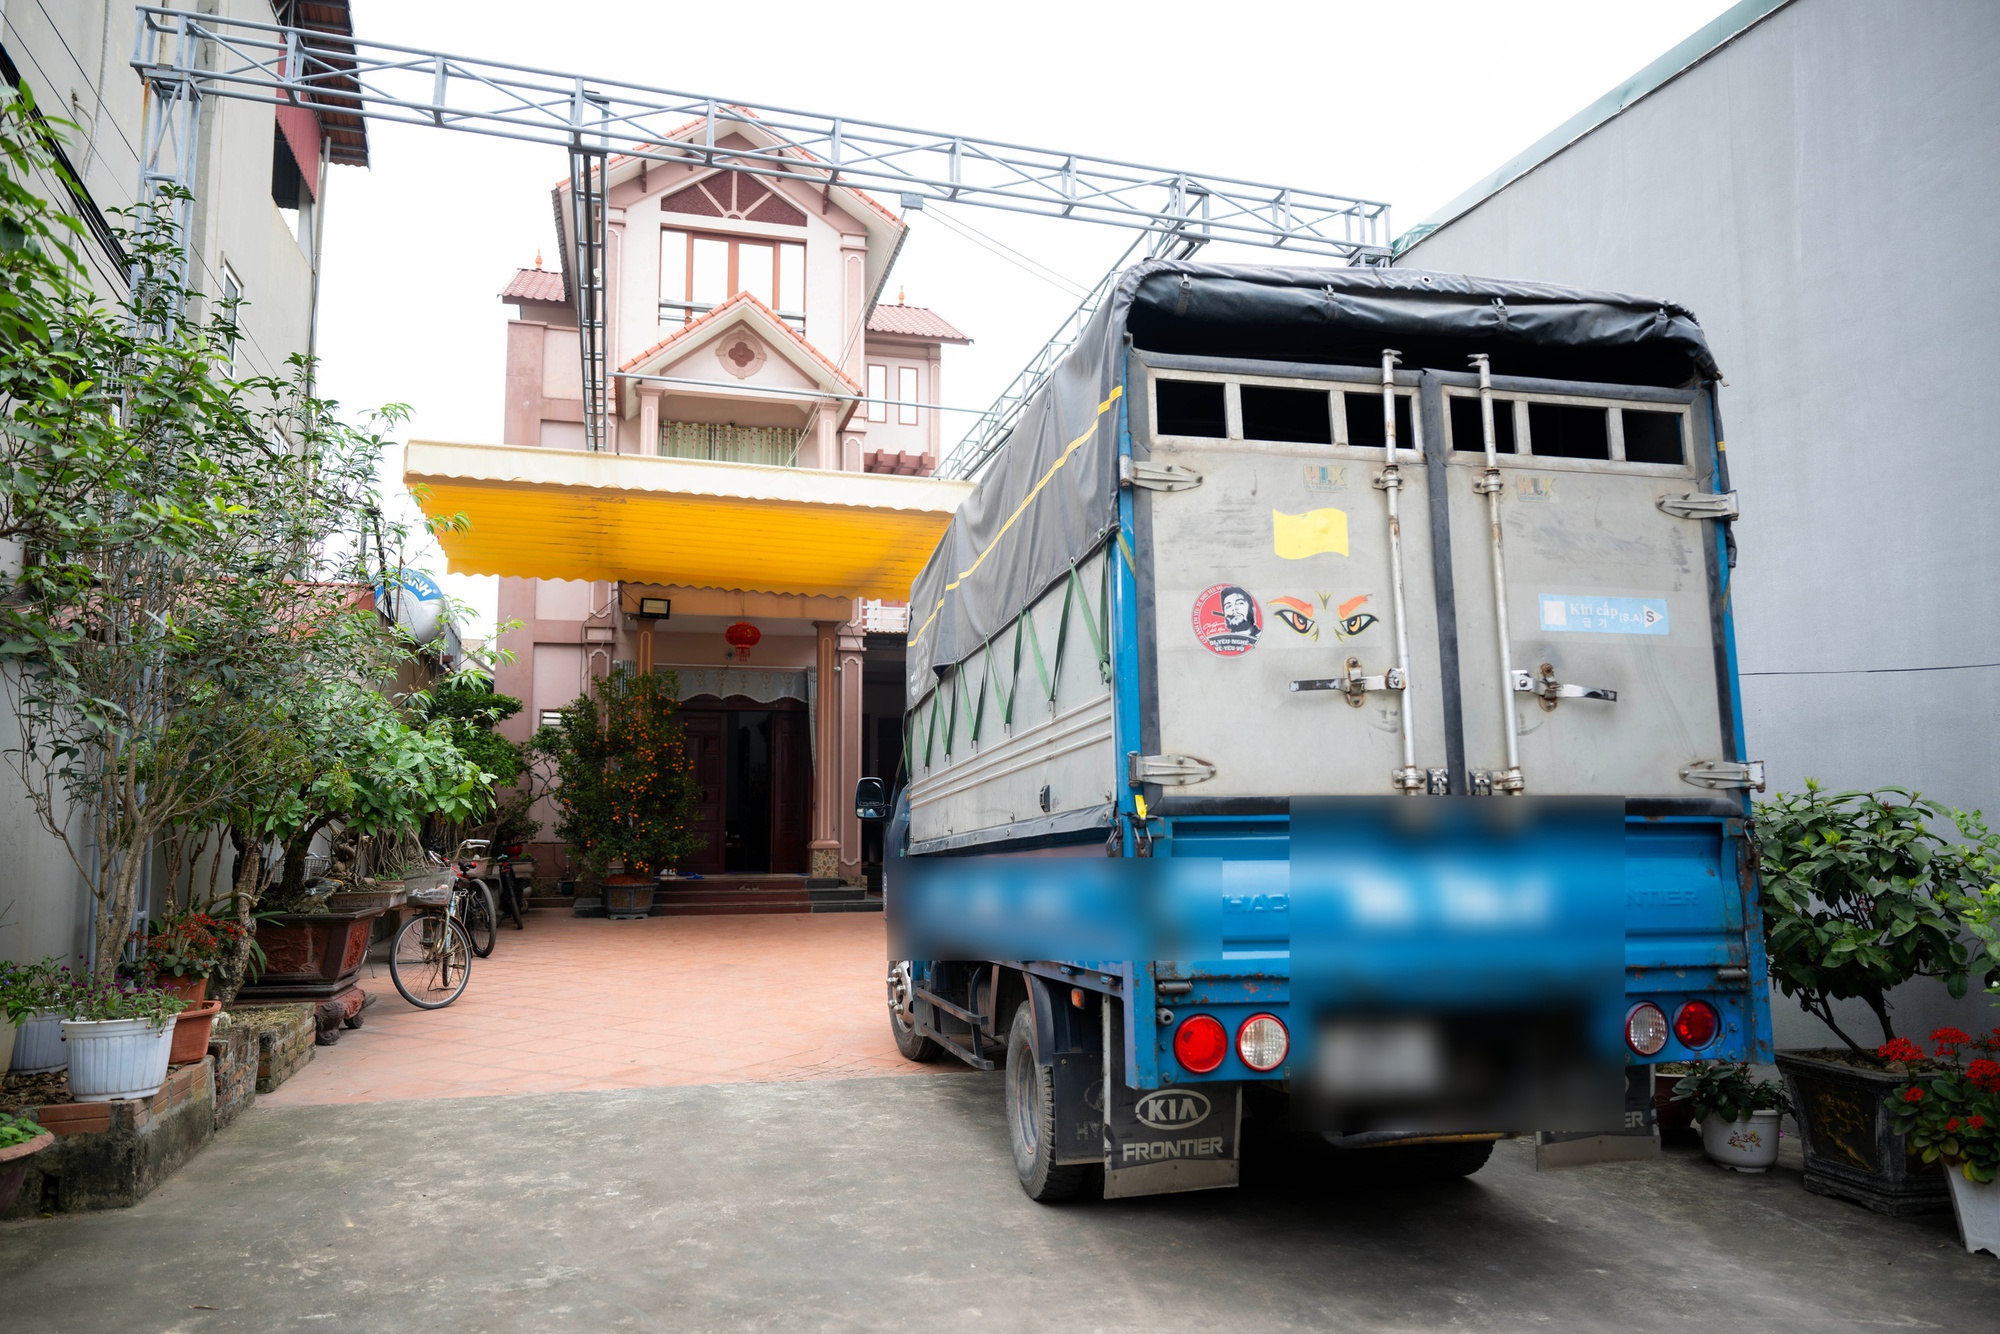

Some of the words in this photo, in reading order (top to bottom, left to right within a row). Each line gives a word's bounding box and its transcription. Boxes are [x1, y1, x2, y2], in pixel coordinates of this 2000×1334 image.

[1570, 603, 1593, 615] Khí
[1646, 610, 1655, 623] S
[1148, 1098, 1200, 1121] KIA
[1122, 1136, 1224, 1162] FRONTIER
